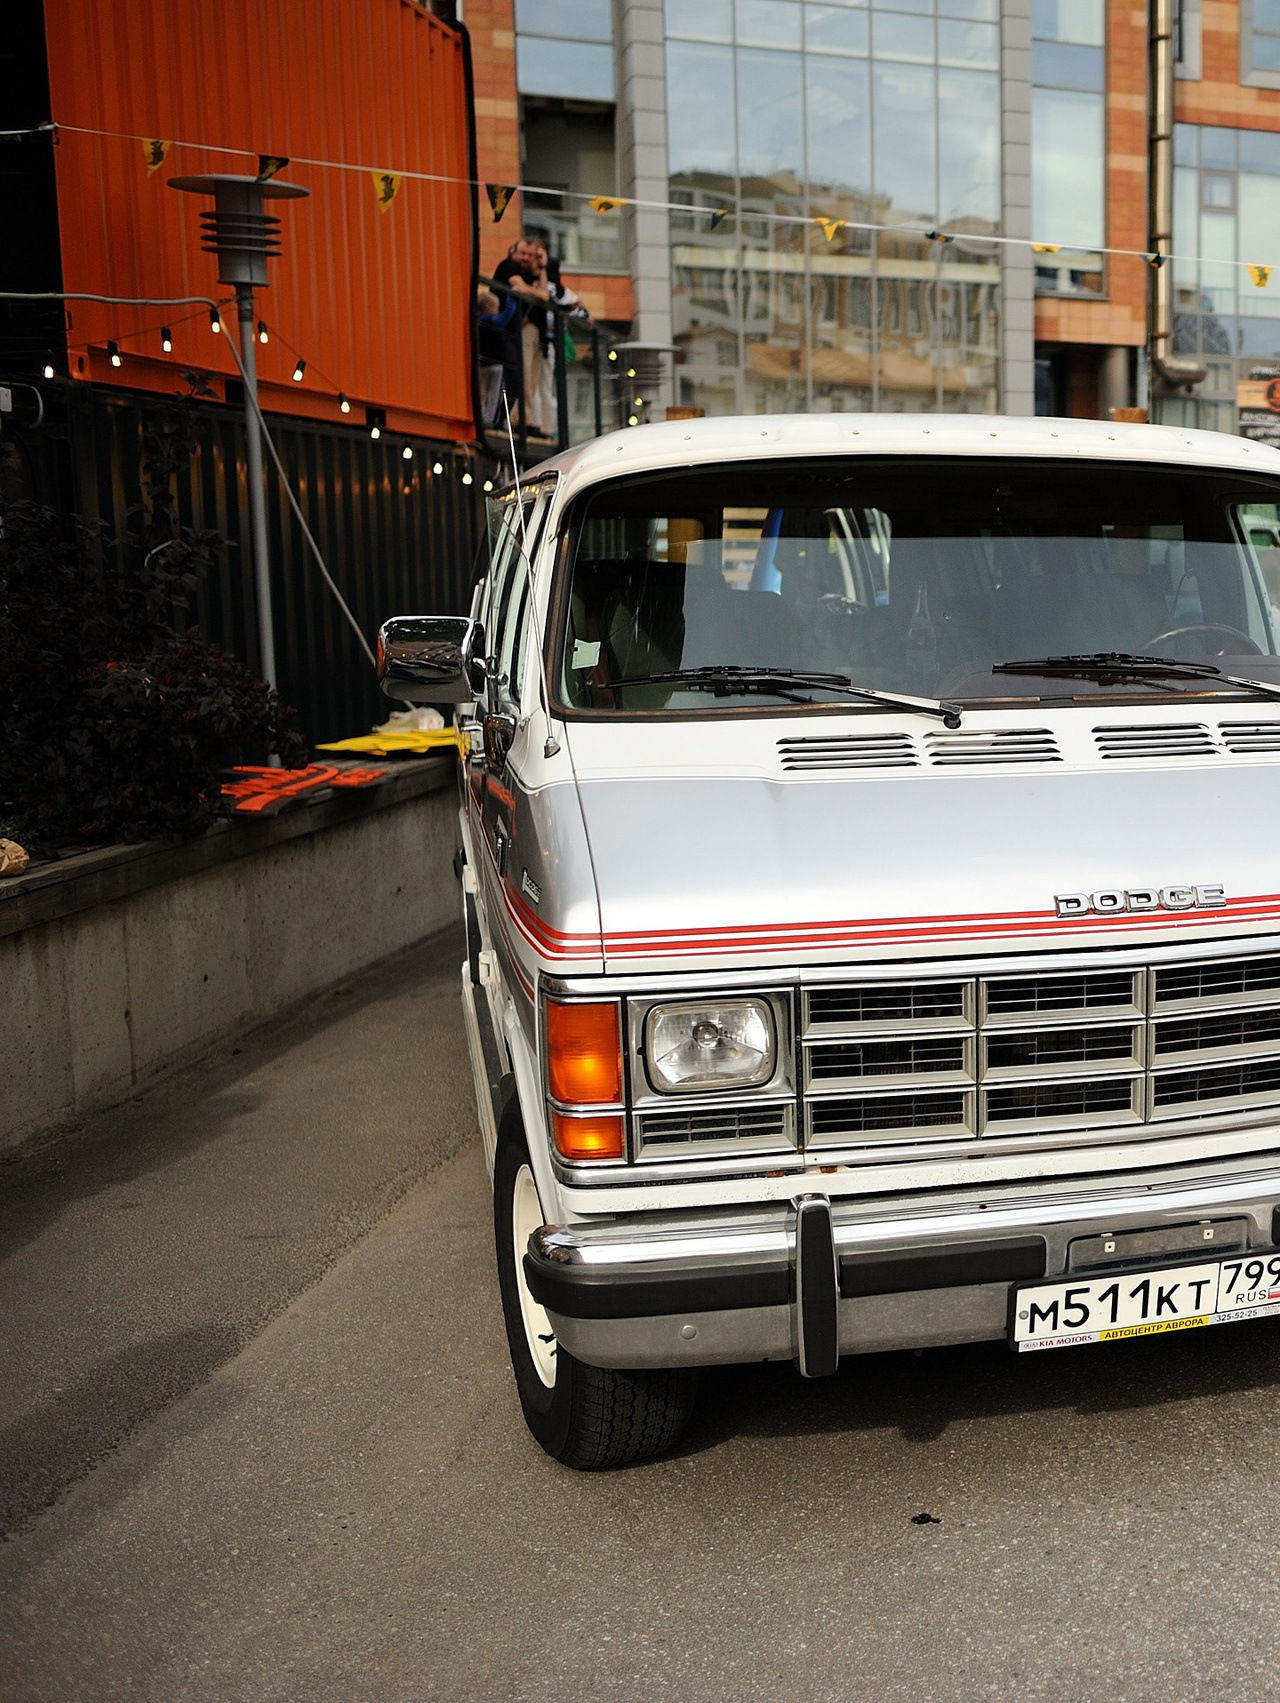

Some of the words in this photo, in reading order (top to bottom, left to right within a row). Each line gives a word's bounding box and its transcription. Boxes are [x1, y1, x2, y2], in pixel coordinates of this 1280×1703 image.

[1053, 883, 1227, 918] DODGE
[1235, 1289, 1267, 1304] RUS
[1104, 1323, 1163, 1340] АВТОЦЕНТР
[1165, 1317, 1204, 1331] АВРОРА
[1040, 1339, 1054, 1347] KIA
[1056, 1335, 1093, 1345] MOTORS
